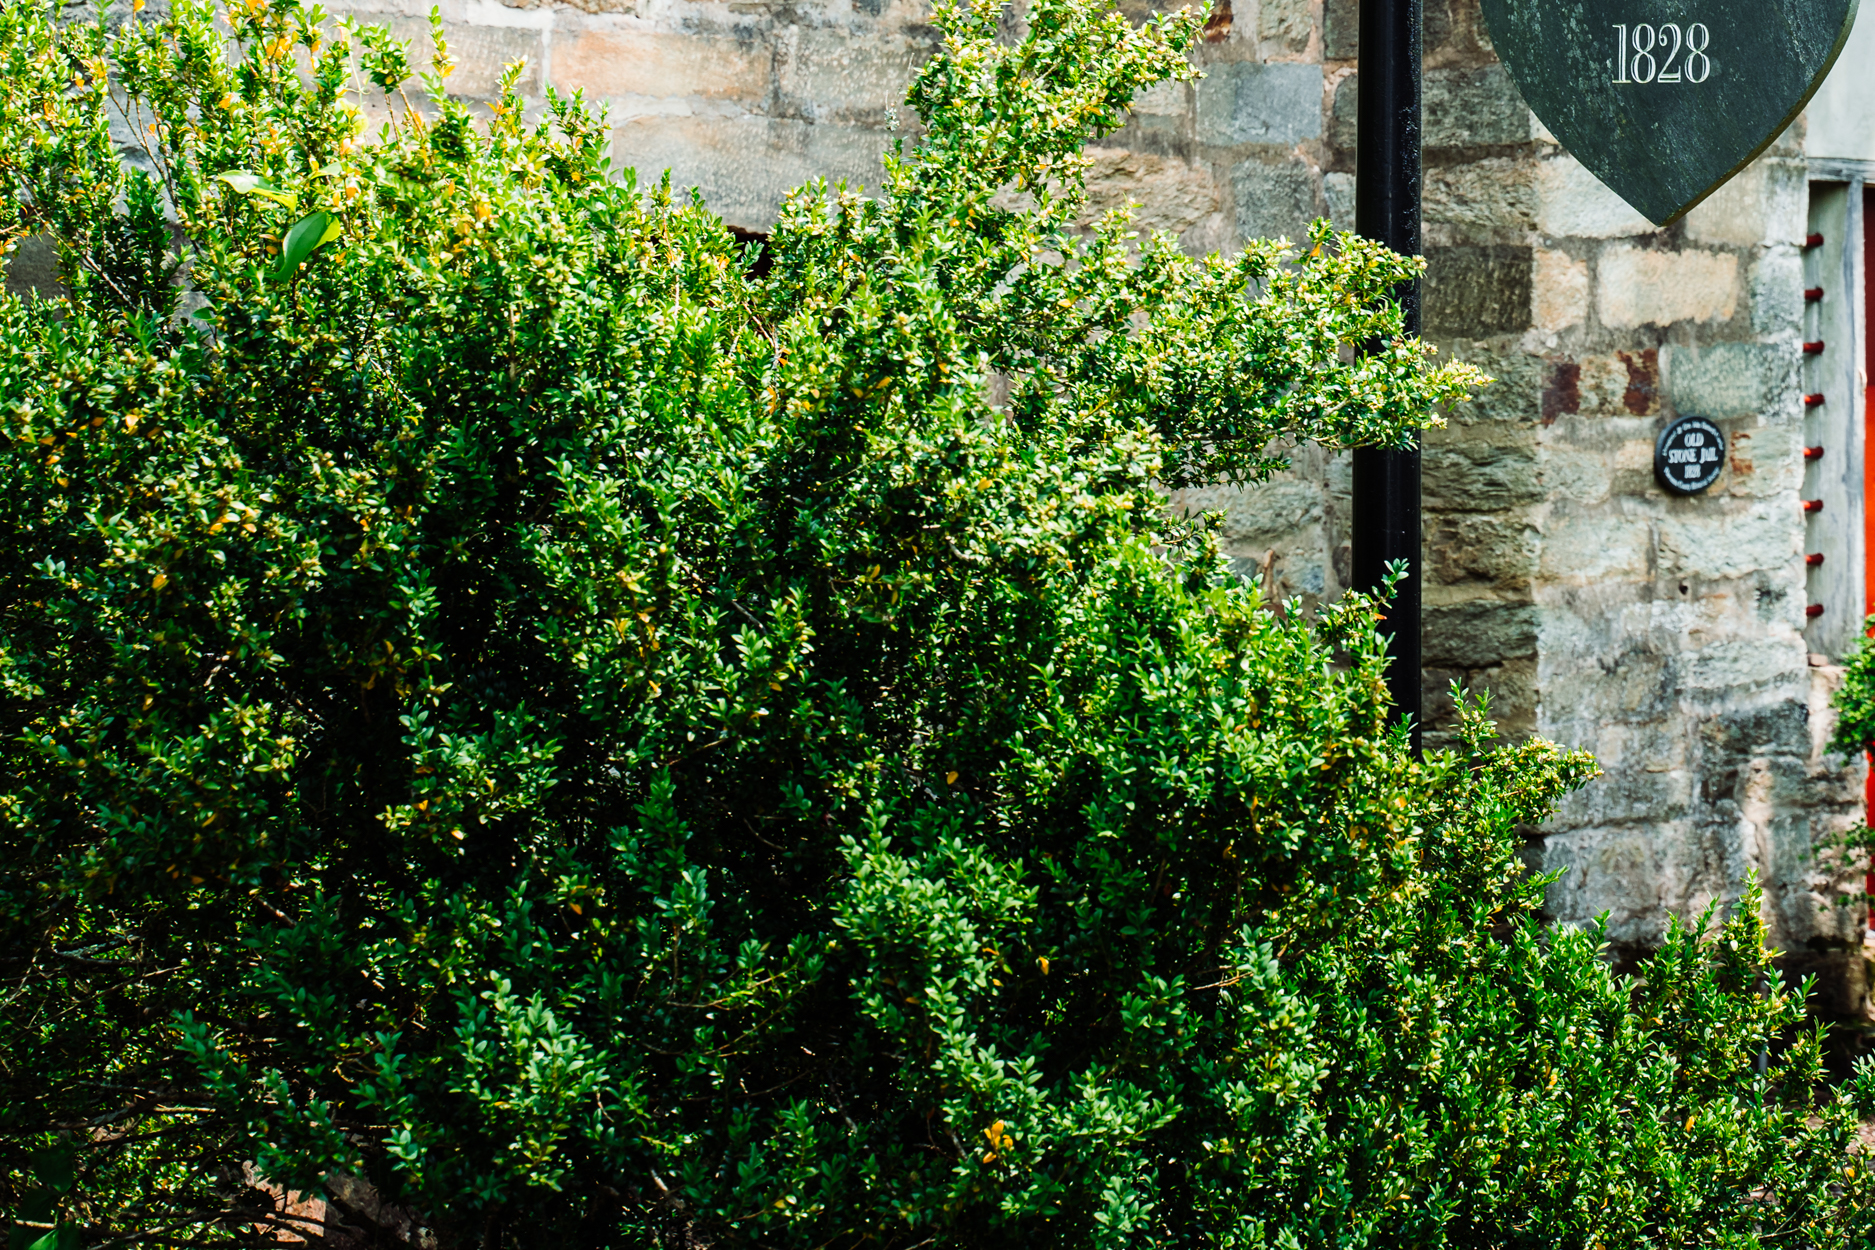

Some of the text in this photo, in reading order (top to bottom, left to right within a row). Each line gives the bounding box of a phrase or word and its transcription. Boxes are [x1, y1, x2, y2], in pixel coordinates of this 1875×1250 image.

[1611, 22, 1711, 85] 1828
[1684, 432, 1704, 447] OLD
[1668, 447, 1718, 464] STONE JAIL
